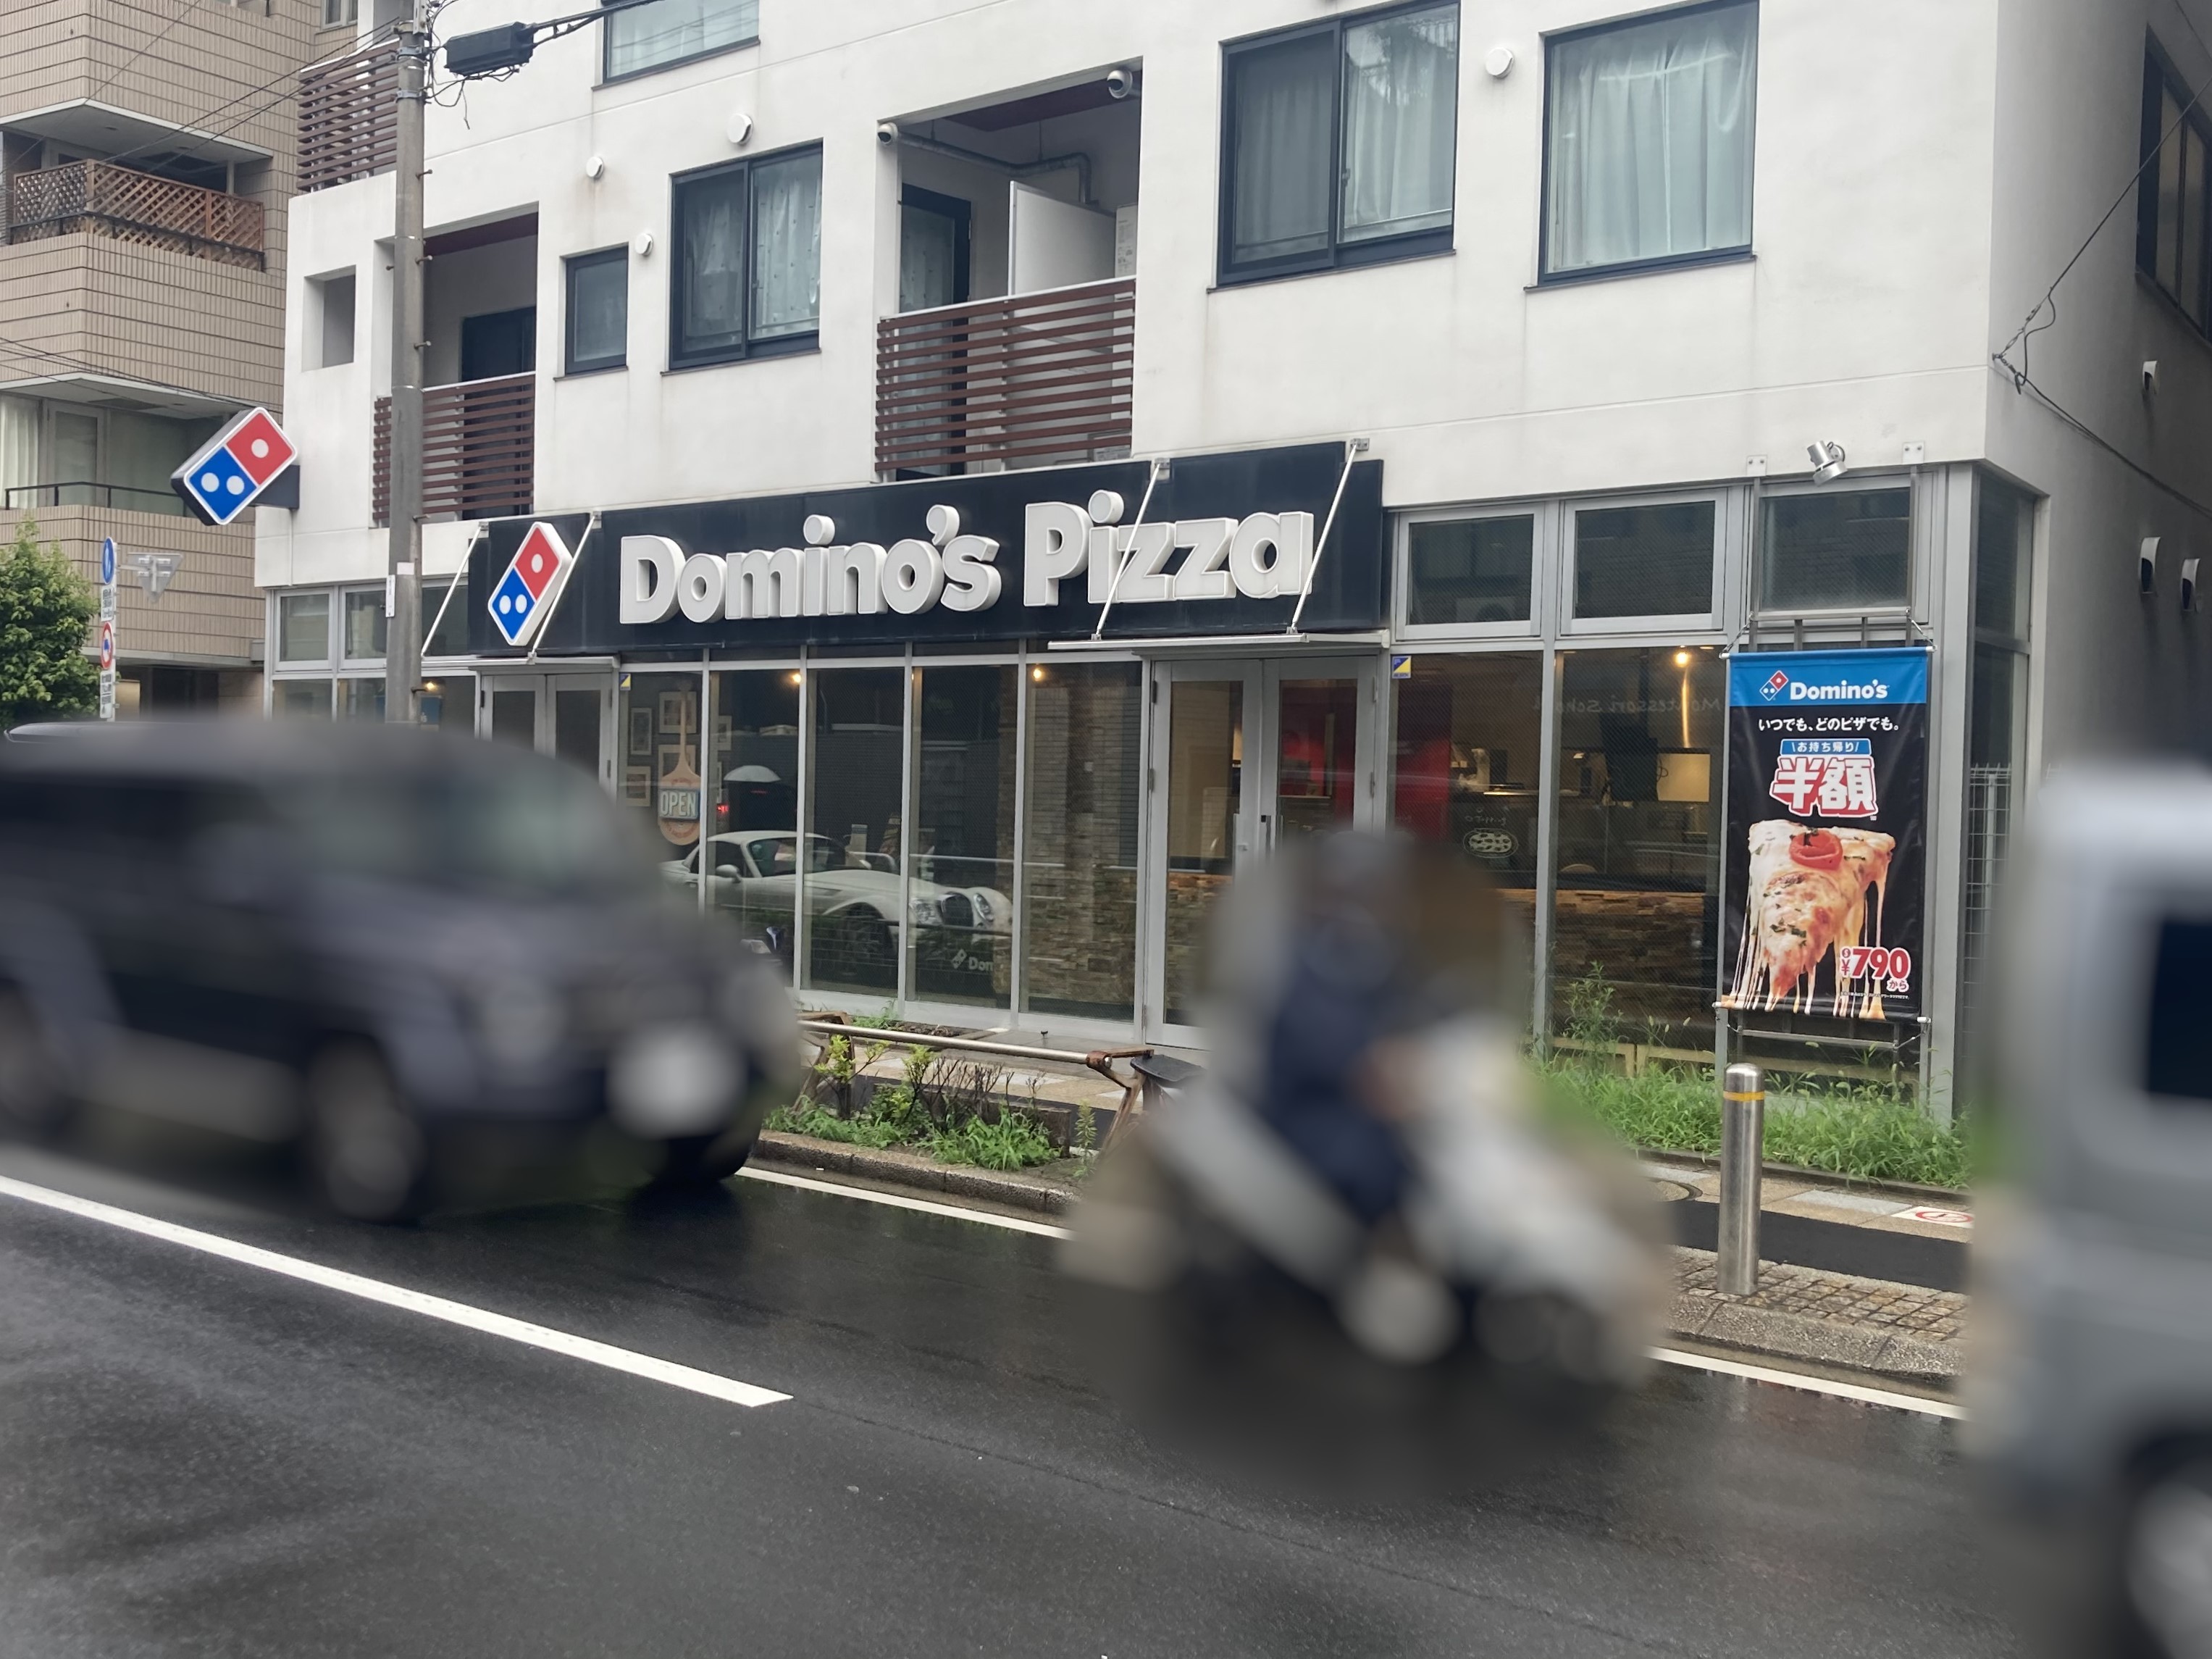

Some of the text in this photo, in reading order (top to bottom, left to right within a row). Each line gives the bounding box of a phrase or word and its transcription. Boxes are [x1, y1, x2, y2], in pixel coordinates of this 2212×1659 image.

[620, 490, 1315, 624] Domino's Pizza
[1790, 680, 1888, 700] Domino's
[1772, 756, 1877, 814] 半額
[660, 790, 697, 817] OPEN
[1889, 980, 1907, 990] から
